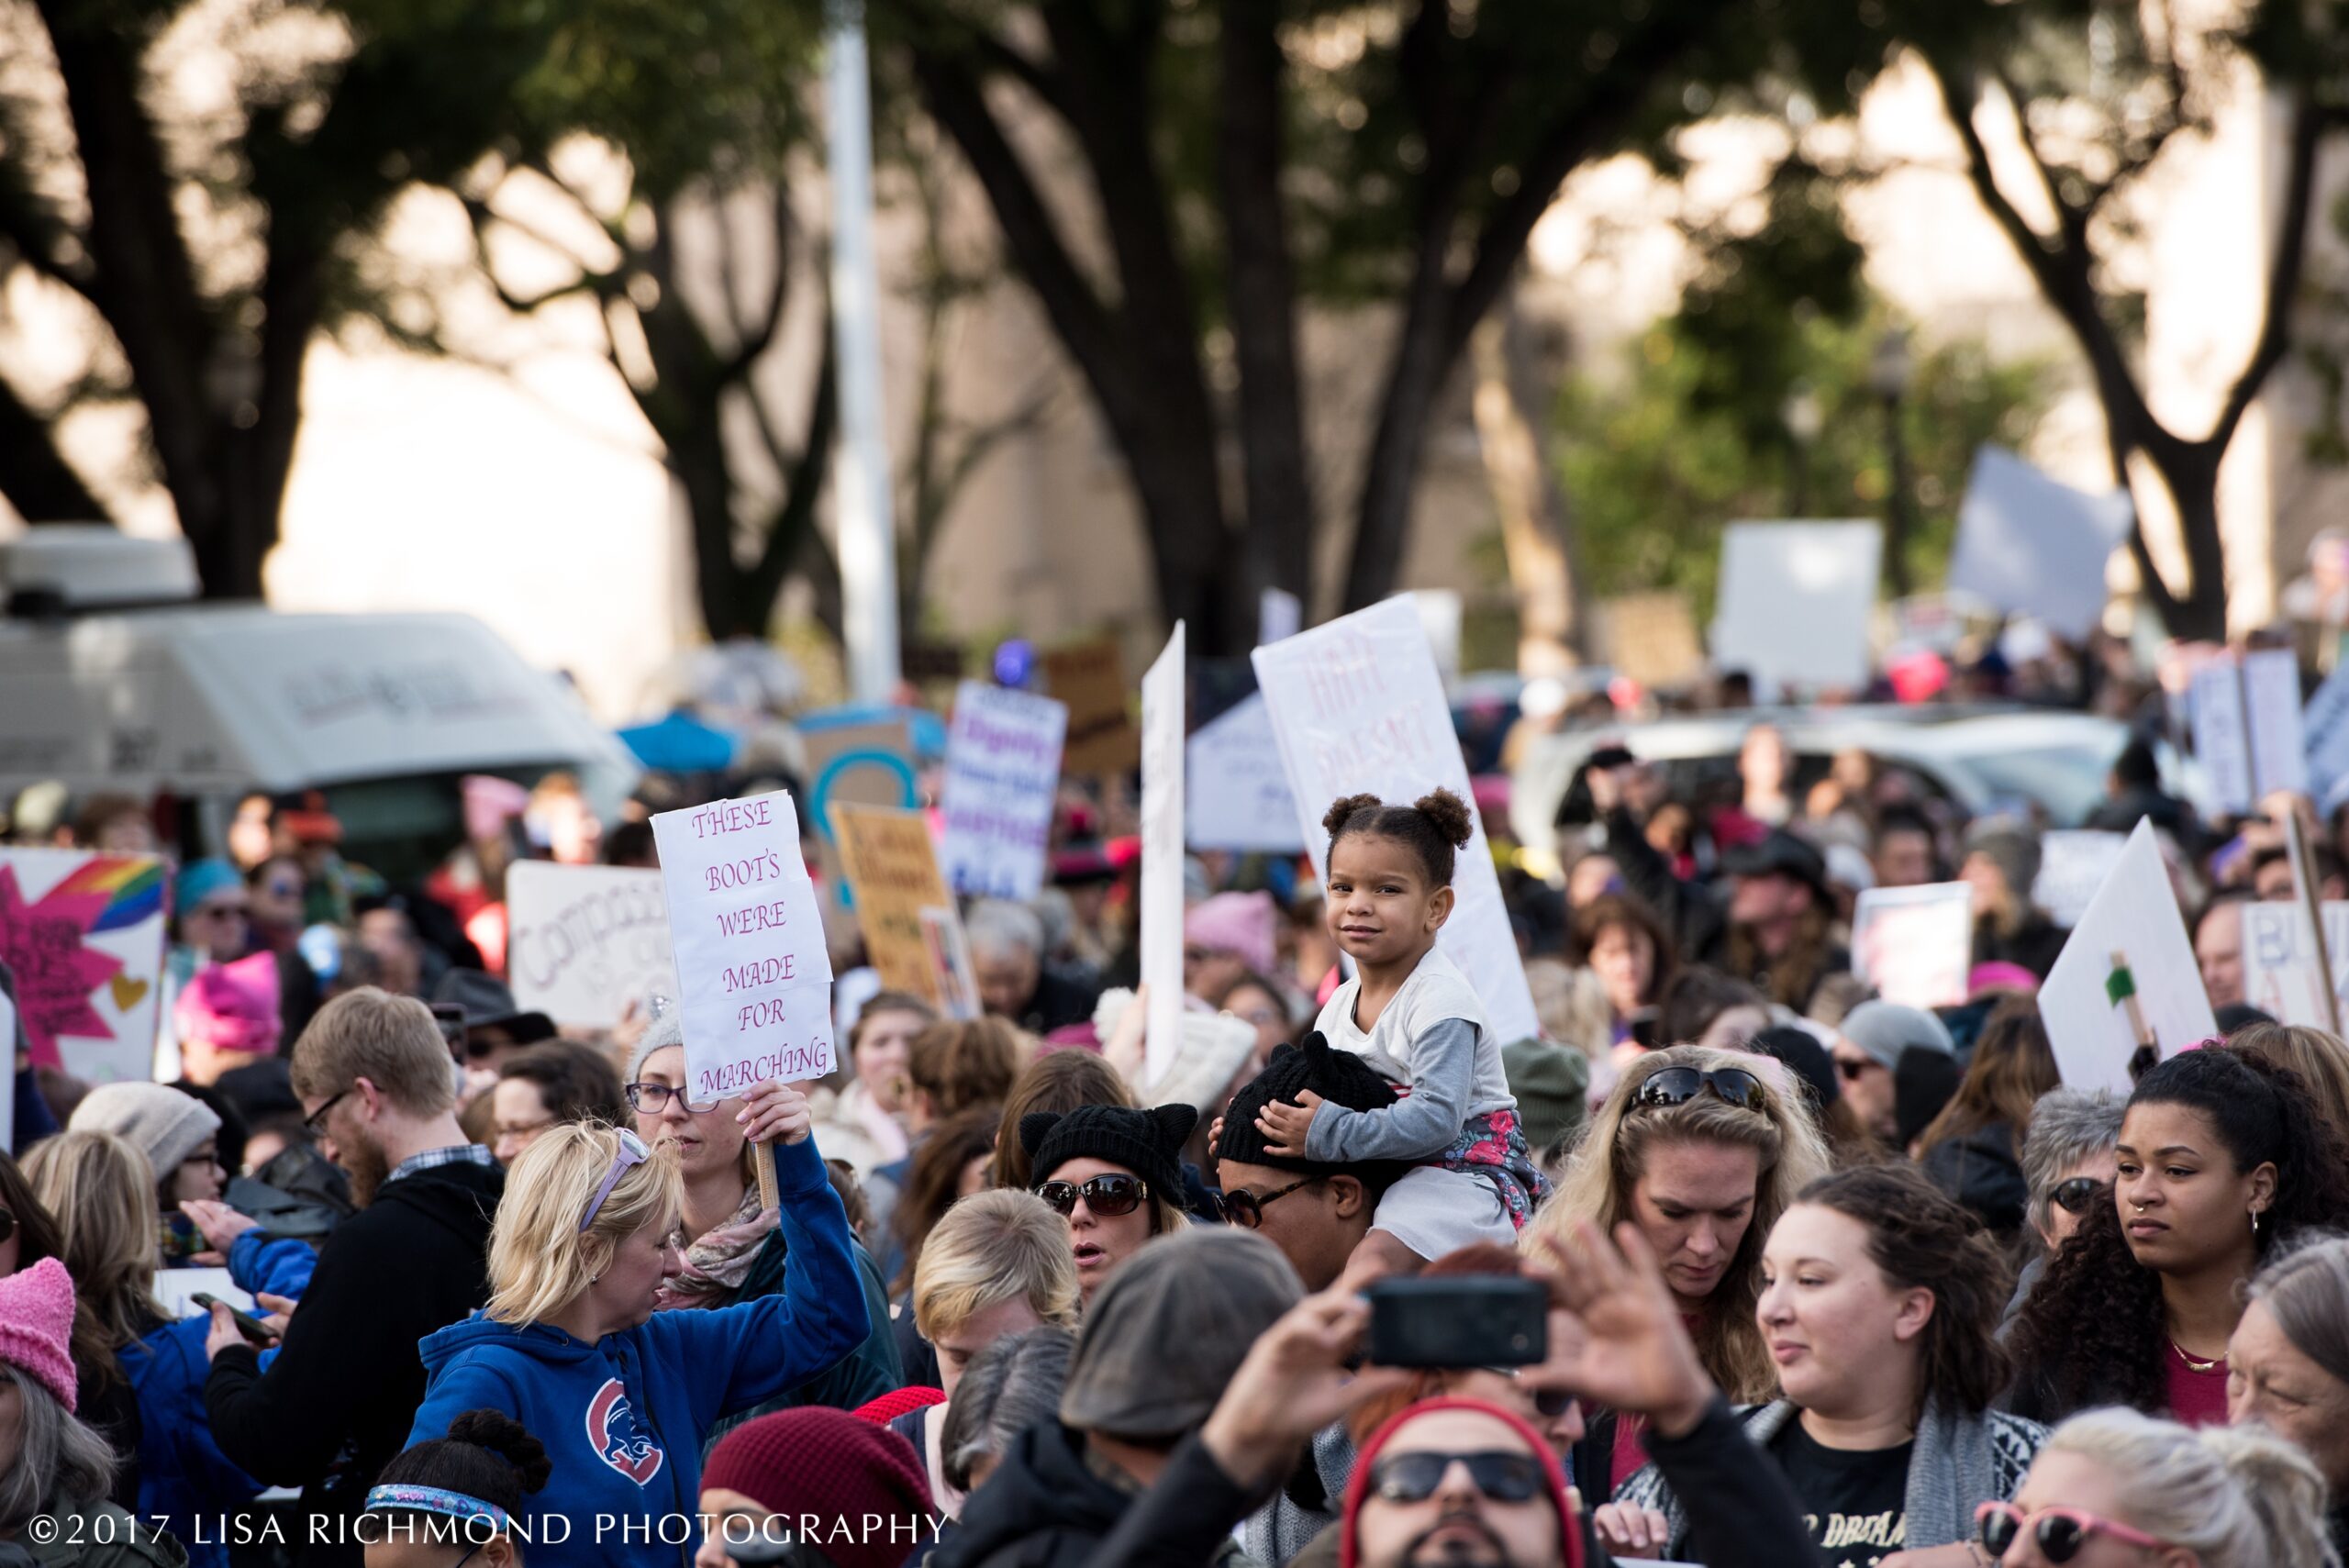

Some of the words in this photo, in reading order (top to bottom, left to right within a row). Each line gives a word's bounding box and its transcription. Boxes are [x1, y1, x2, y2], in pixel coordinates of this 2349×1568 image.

[692, 800, 773, 839] THESE
[705, 848, 781, 892] BOOTS
[717, 901, 787, 938] WERE
[722, 953, 796, 993] MADE
[738, 998, 786, 1031] FOR
[699, 1036, 827, 1095] MARCHING
